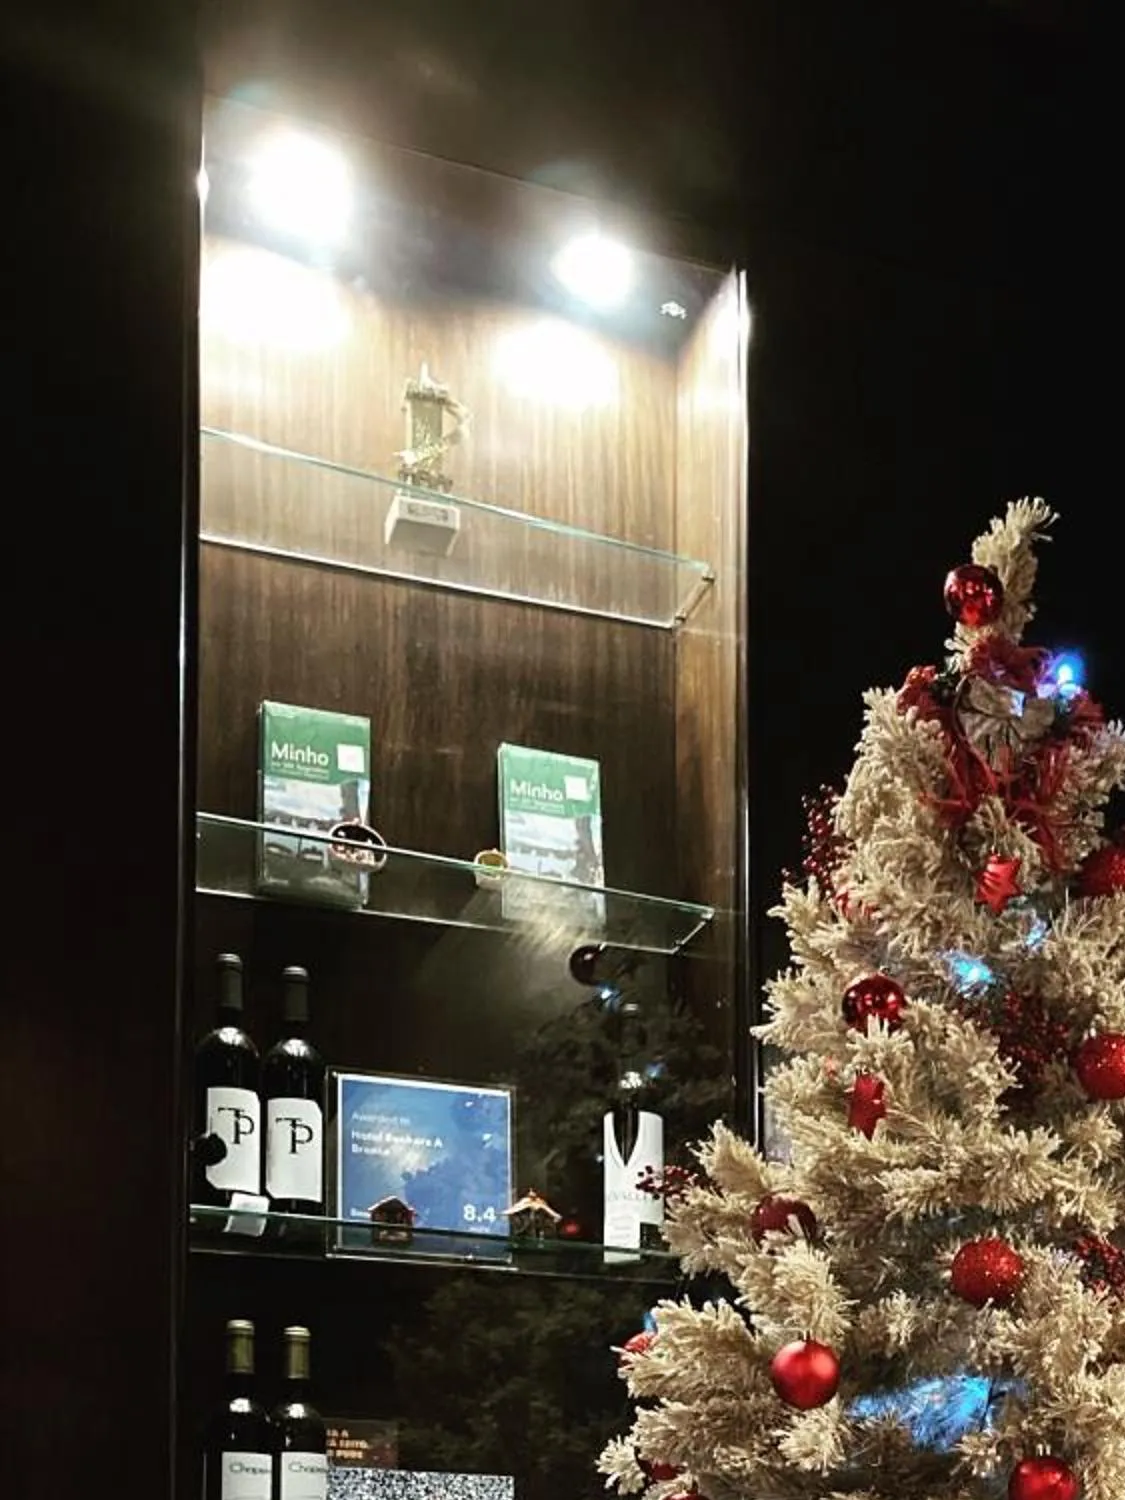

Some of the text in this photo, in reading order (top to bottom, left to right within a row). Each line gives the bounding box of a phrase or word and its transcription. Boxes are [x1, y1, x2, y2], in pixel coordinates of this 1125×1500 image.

[271, 741, 330, 766] Minho
[509, 779, 564, 802] Minho
[463, 1203, 497, 1223] 8.4
